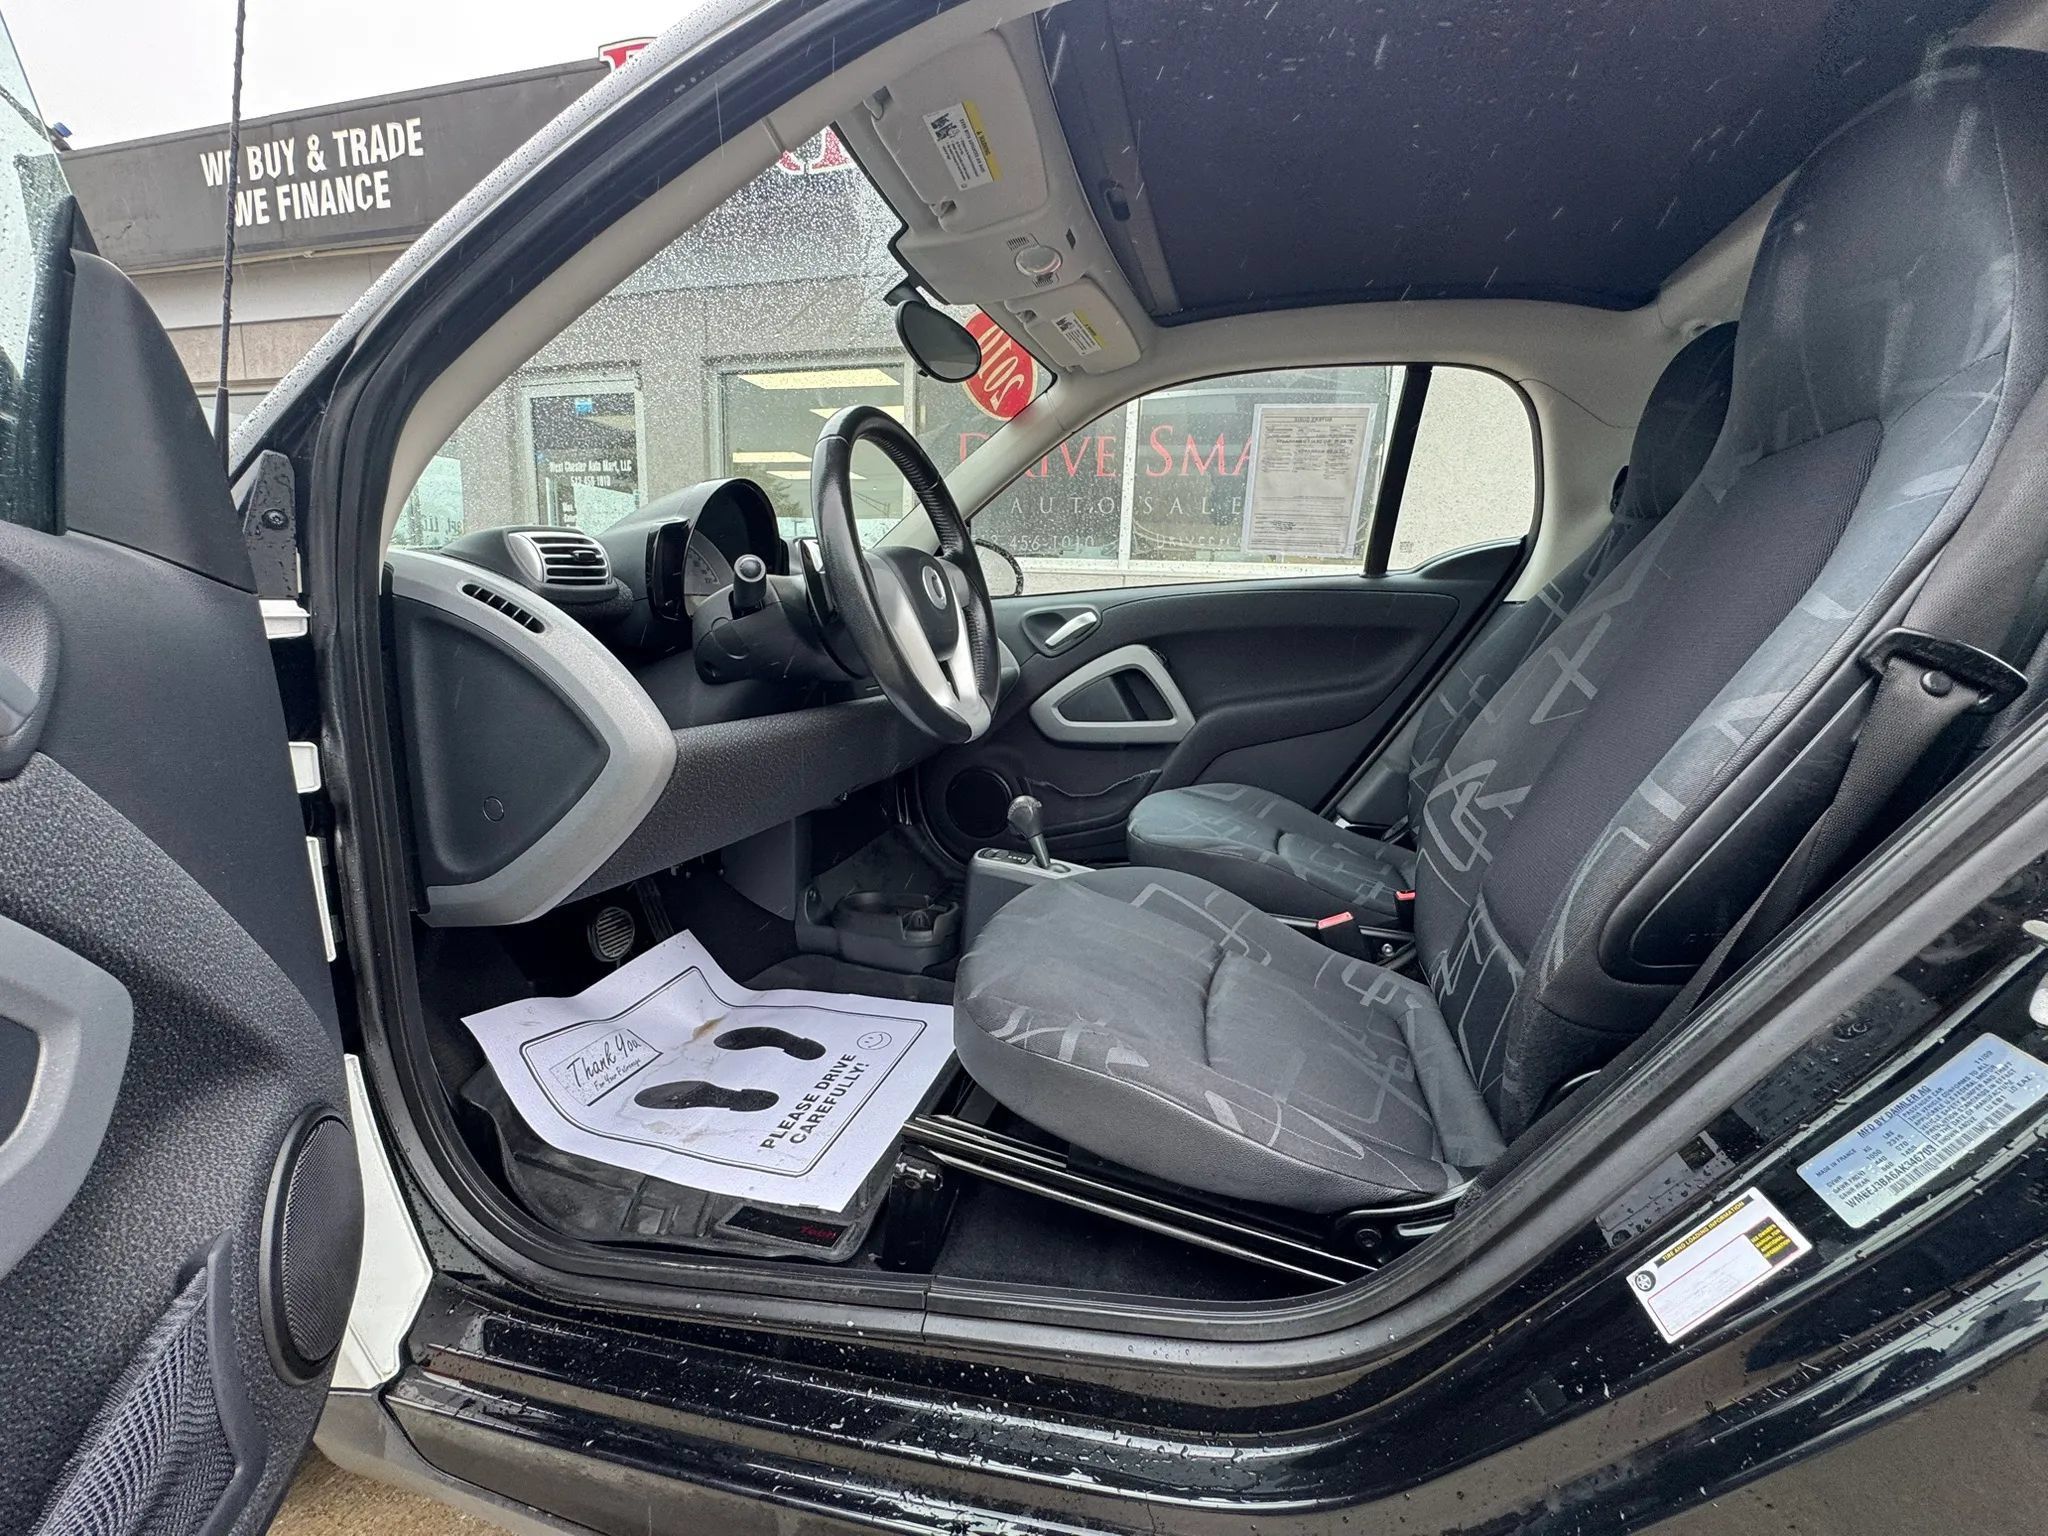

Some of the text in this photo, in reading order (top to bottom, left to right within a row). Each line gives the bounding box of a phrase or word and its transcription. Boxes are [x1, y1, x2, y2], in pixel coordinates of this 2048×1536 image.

[200, 117, 424, 187] W BUY & TRADE
[235, 170, 391, 227] WE FINANCE
[620, 459, 632, 471] LLC
[959, 432, 1118, 478] IVE
[1010, 496, 1116, 515] AUTO
[566, 1033, 642, 1088] Thank You
[1968, 1068, 1979, 1077] TO
[1976, 1060, 1989, 1071] ALL
[759, 1054, 857, 1149] PLEASE DRIVE
[789, 1062, 870, 1144] CAREFULLY!
[1856, 1122, 1876, 1138] MFD
[1873, 1113, 1889, 1126] BY
[1885, 1091, 1920, 1118] DAIMLER
[1815, 1164, 1831, 1177] MADE
[1836, 1147, 1857, 1163] FRANCE
[1661, 1200, 1745, 1261] TIRE AND LOADING INFORMATION
